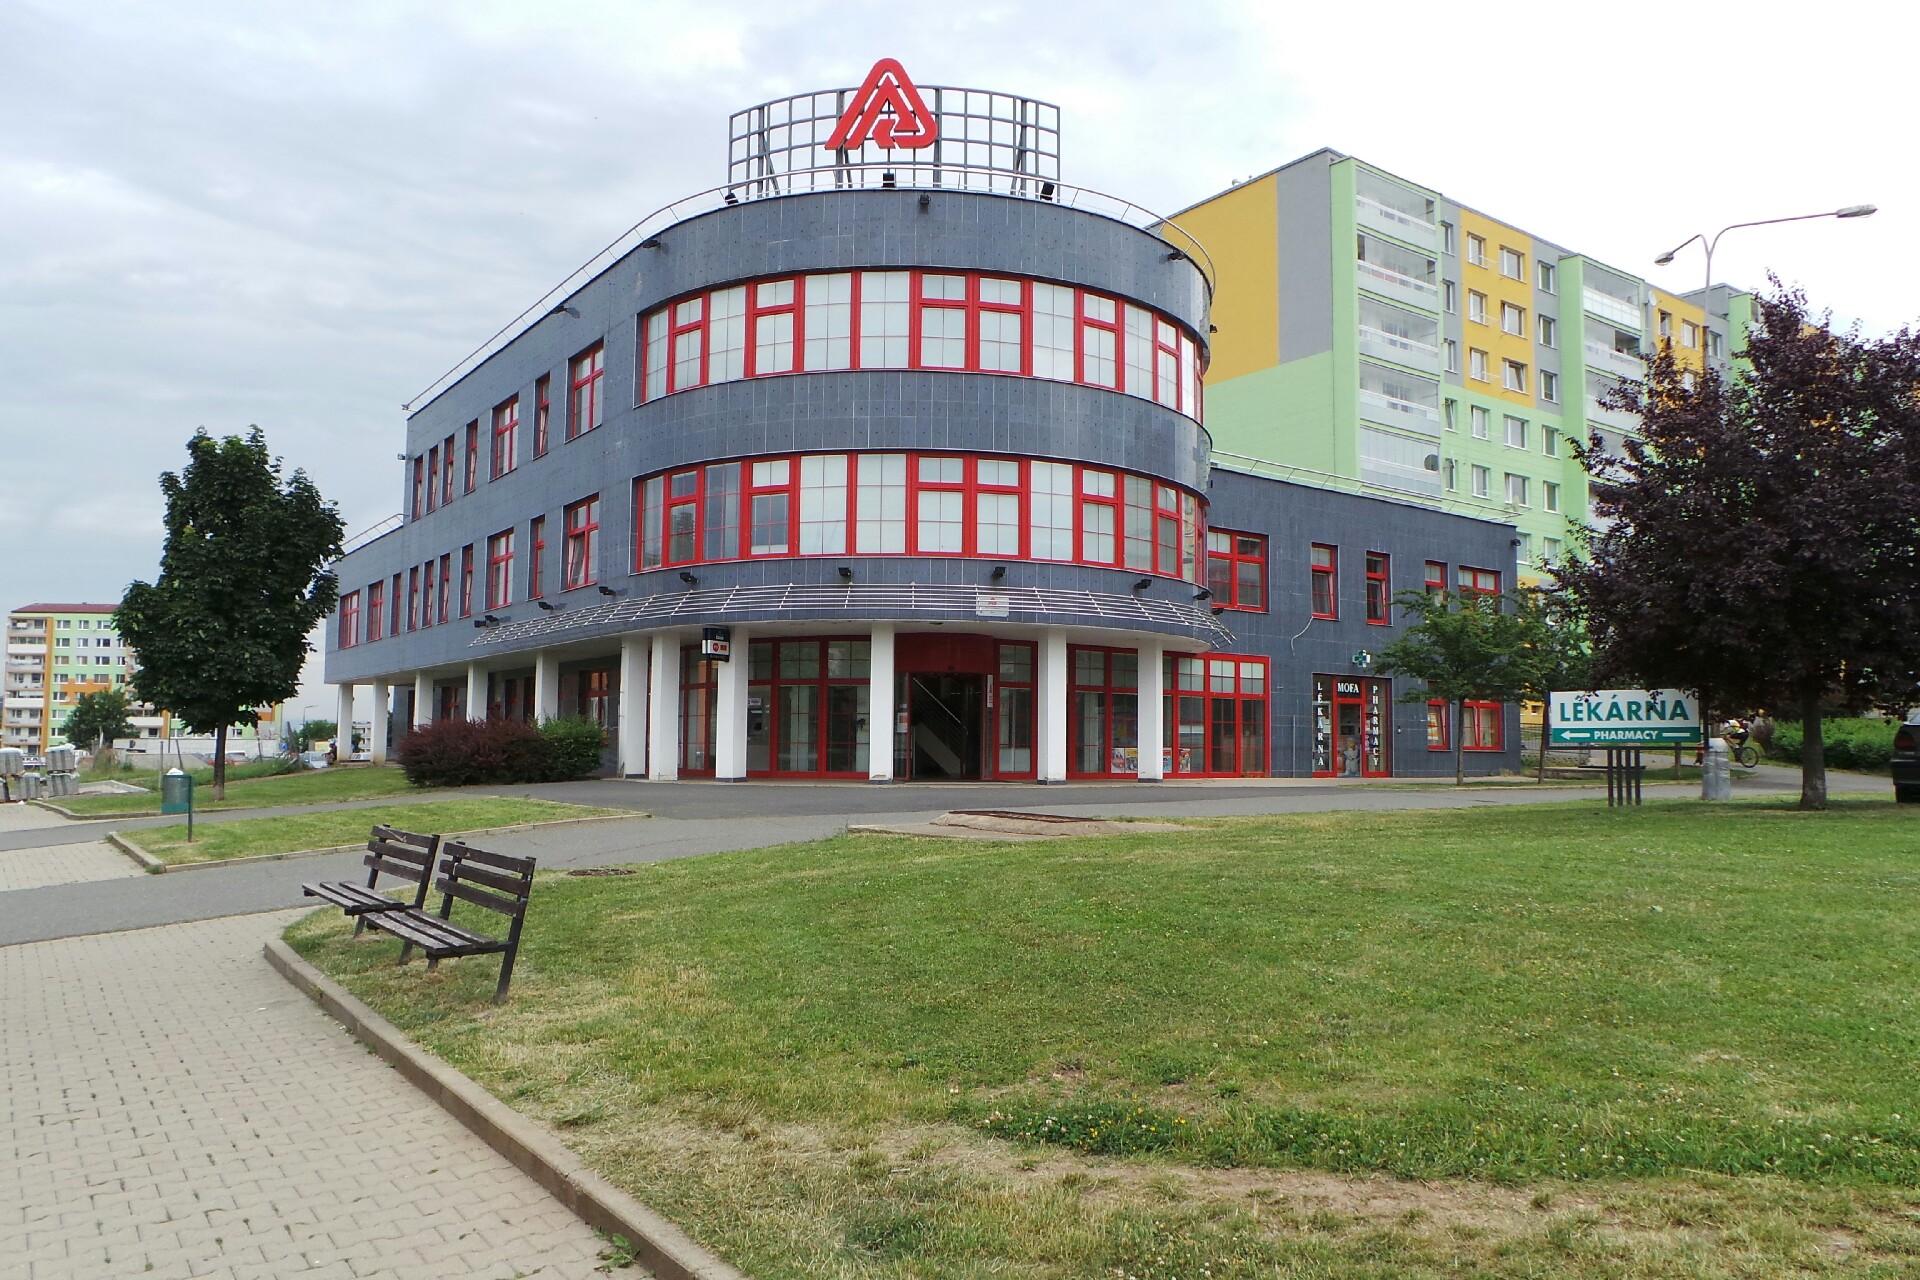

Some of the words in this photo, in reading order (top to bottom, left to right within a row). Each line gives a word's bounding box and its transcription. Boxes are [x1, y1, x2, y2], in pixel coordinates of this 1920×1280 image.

[1337, 682, 1360, 694] MOFA
[1559, 693, 1690, 722] LÉKÁRNA
[1593, 730, 1659, 740] PHARMACY
